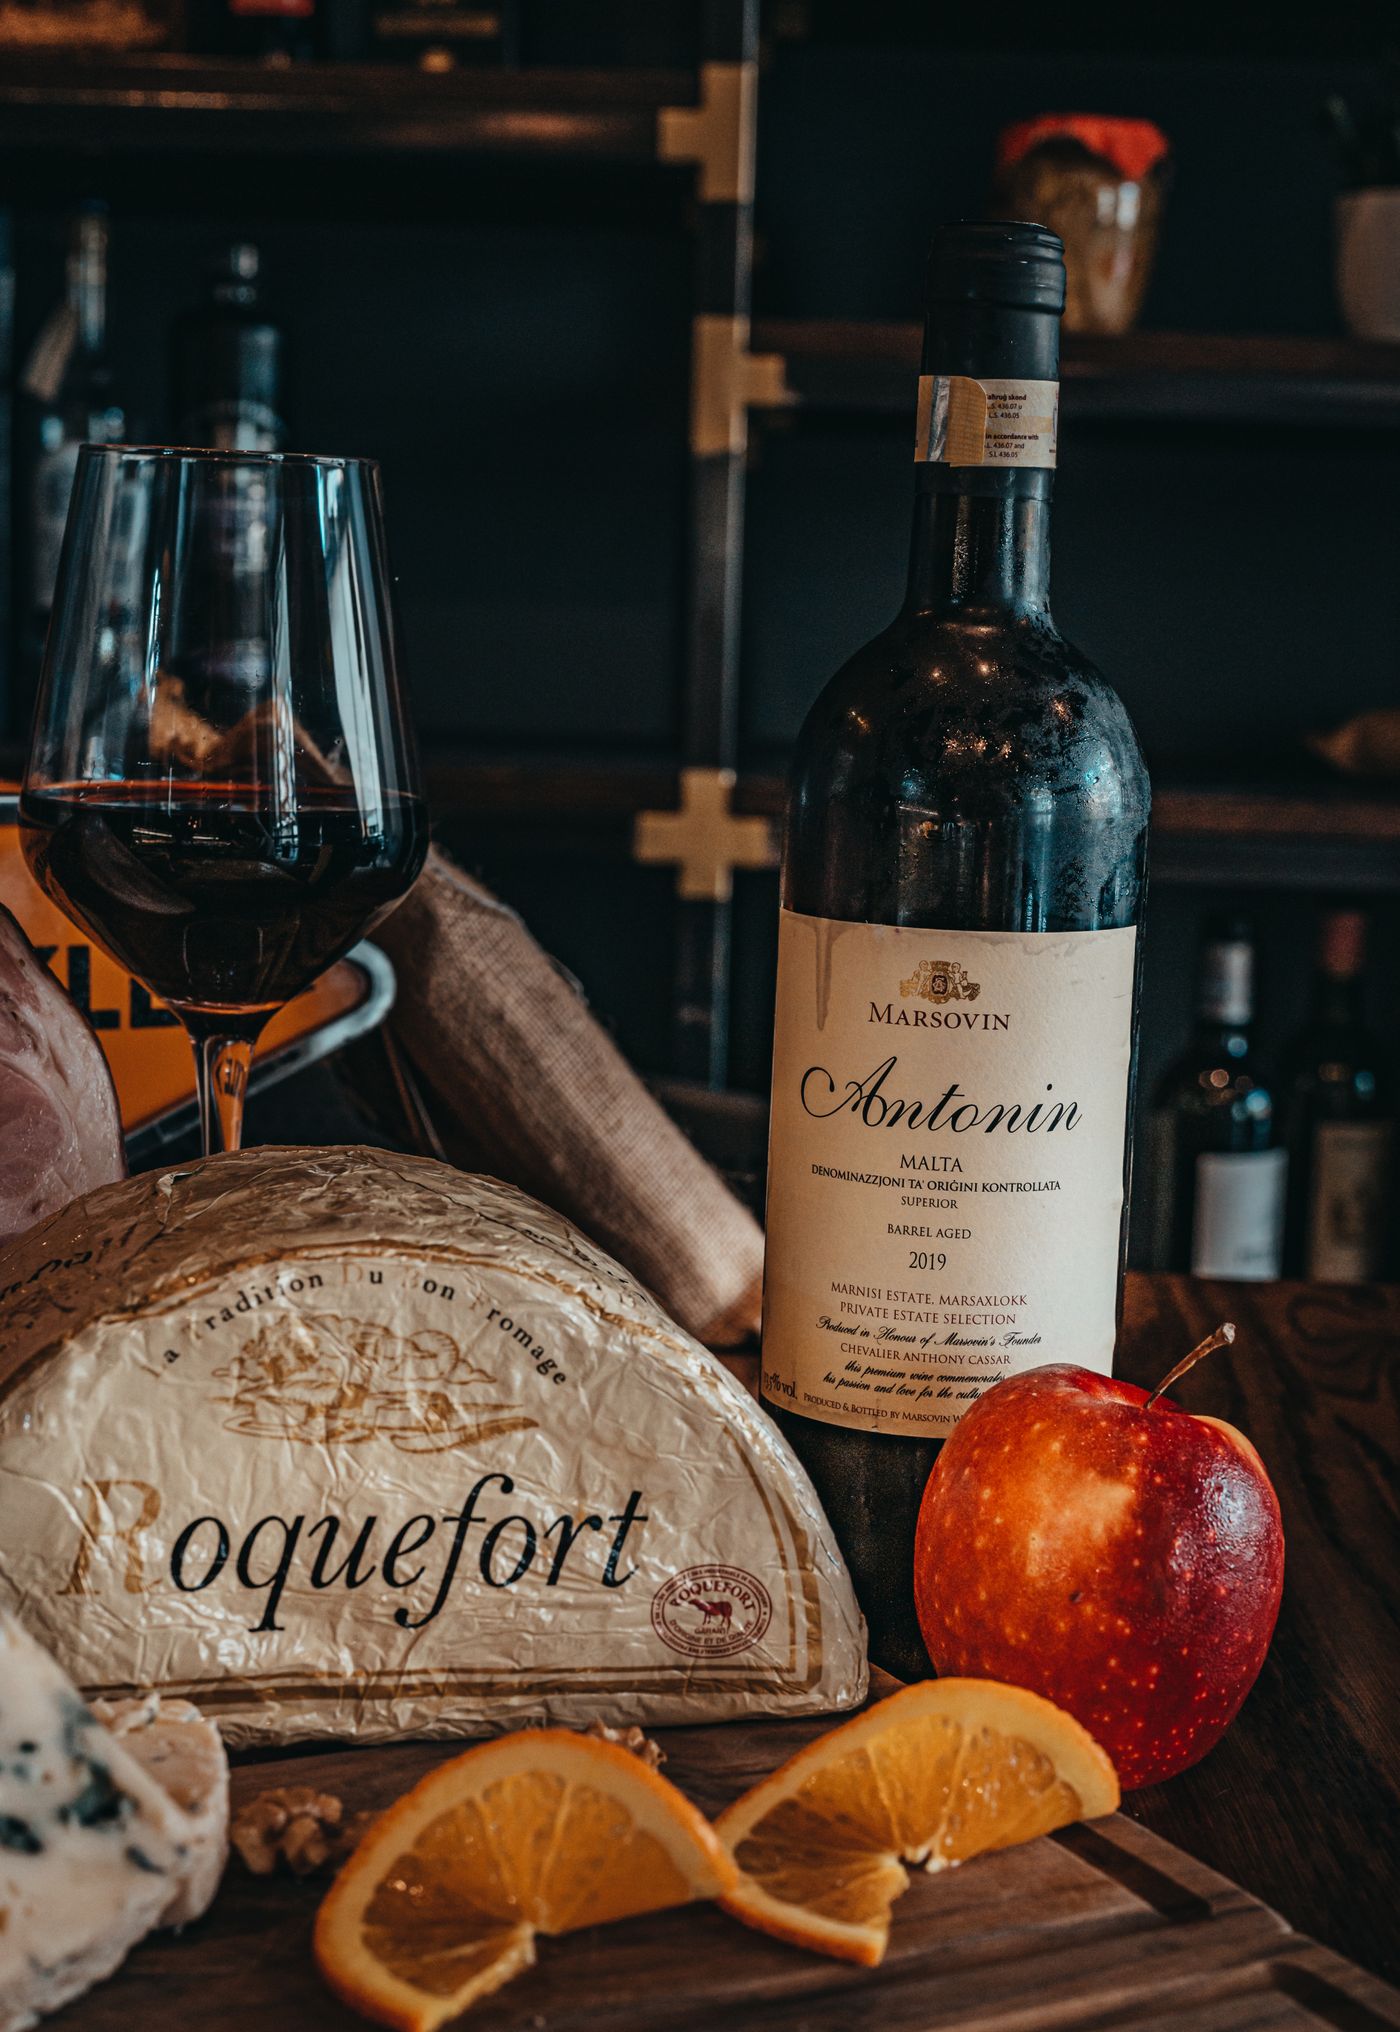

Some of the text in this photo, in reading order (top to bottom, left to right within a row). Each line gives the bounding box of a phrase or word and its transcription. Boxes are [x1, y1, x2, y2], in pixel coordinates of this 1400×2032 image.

[868, 1002, 1011, 1031] MARSOVIN
[800, 1056, 1082, 1133] Antonin
[899, 1154, 963, 1172] MALTA
[811, 1164, 1061, 1192] DENOMINAZZJONI TA' ORIĠINI KONTROLLATA
[901, 1196, 959, 1209] SUPERIOR
[888, 1223, 972, 1240] BARREL AGED
[341, 1263, 384, 1284] Du
[908, 1252, 947, 1271] 2019
[831, 1281, 882, 1300] MARNISI
[939, 1294, 1028, 1306] MARSAXLOKK
[840, 1301, 1016, 1325] PRIVATE ESTATE SELECTION
[816, 1316, 1042, 1349] Produced in Honour of Marsovin's Founder
[840, 1342, 1012, 1365] CHEVALIER ANTHONY CASSAR
[844, 1360, 862, 1373] this
[860, 1366, 906, 1379] premium
[910, 1372, 934, 1381] wine
[822, 1372, 836, 1383] his
[834, 1378, 871, 1390] passion
[874, 1384, 896, 1394] and
[896, 1384, 916, 1396] love
[915, 1386, 933, 1402] for
[936, 1386, 954, 1399] the
[804, 1392, 842, 1410] PRODUCED
[843, 1402, 850, 1412] &
[851, 1404, 888, 1418] BOTTLED
[890, 1410, 900, 1419] BY
[902, 1412, 950, 1423] MARSOVIN
[56, 1472, 649, 1633] Roquefort
